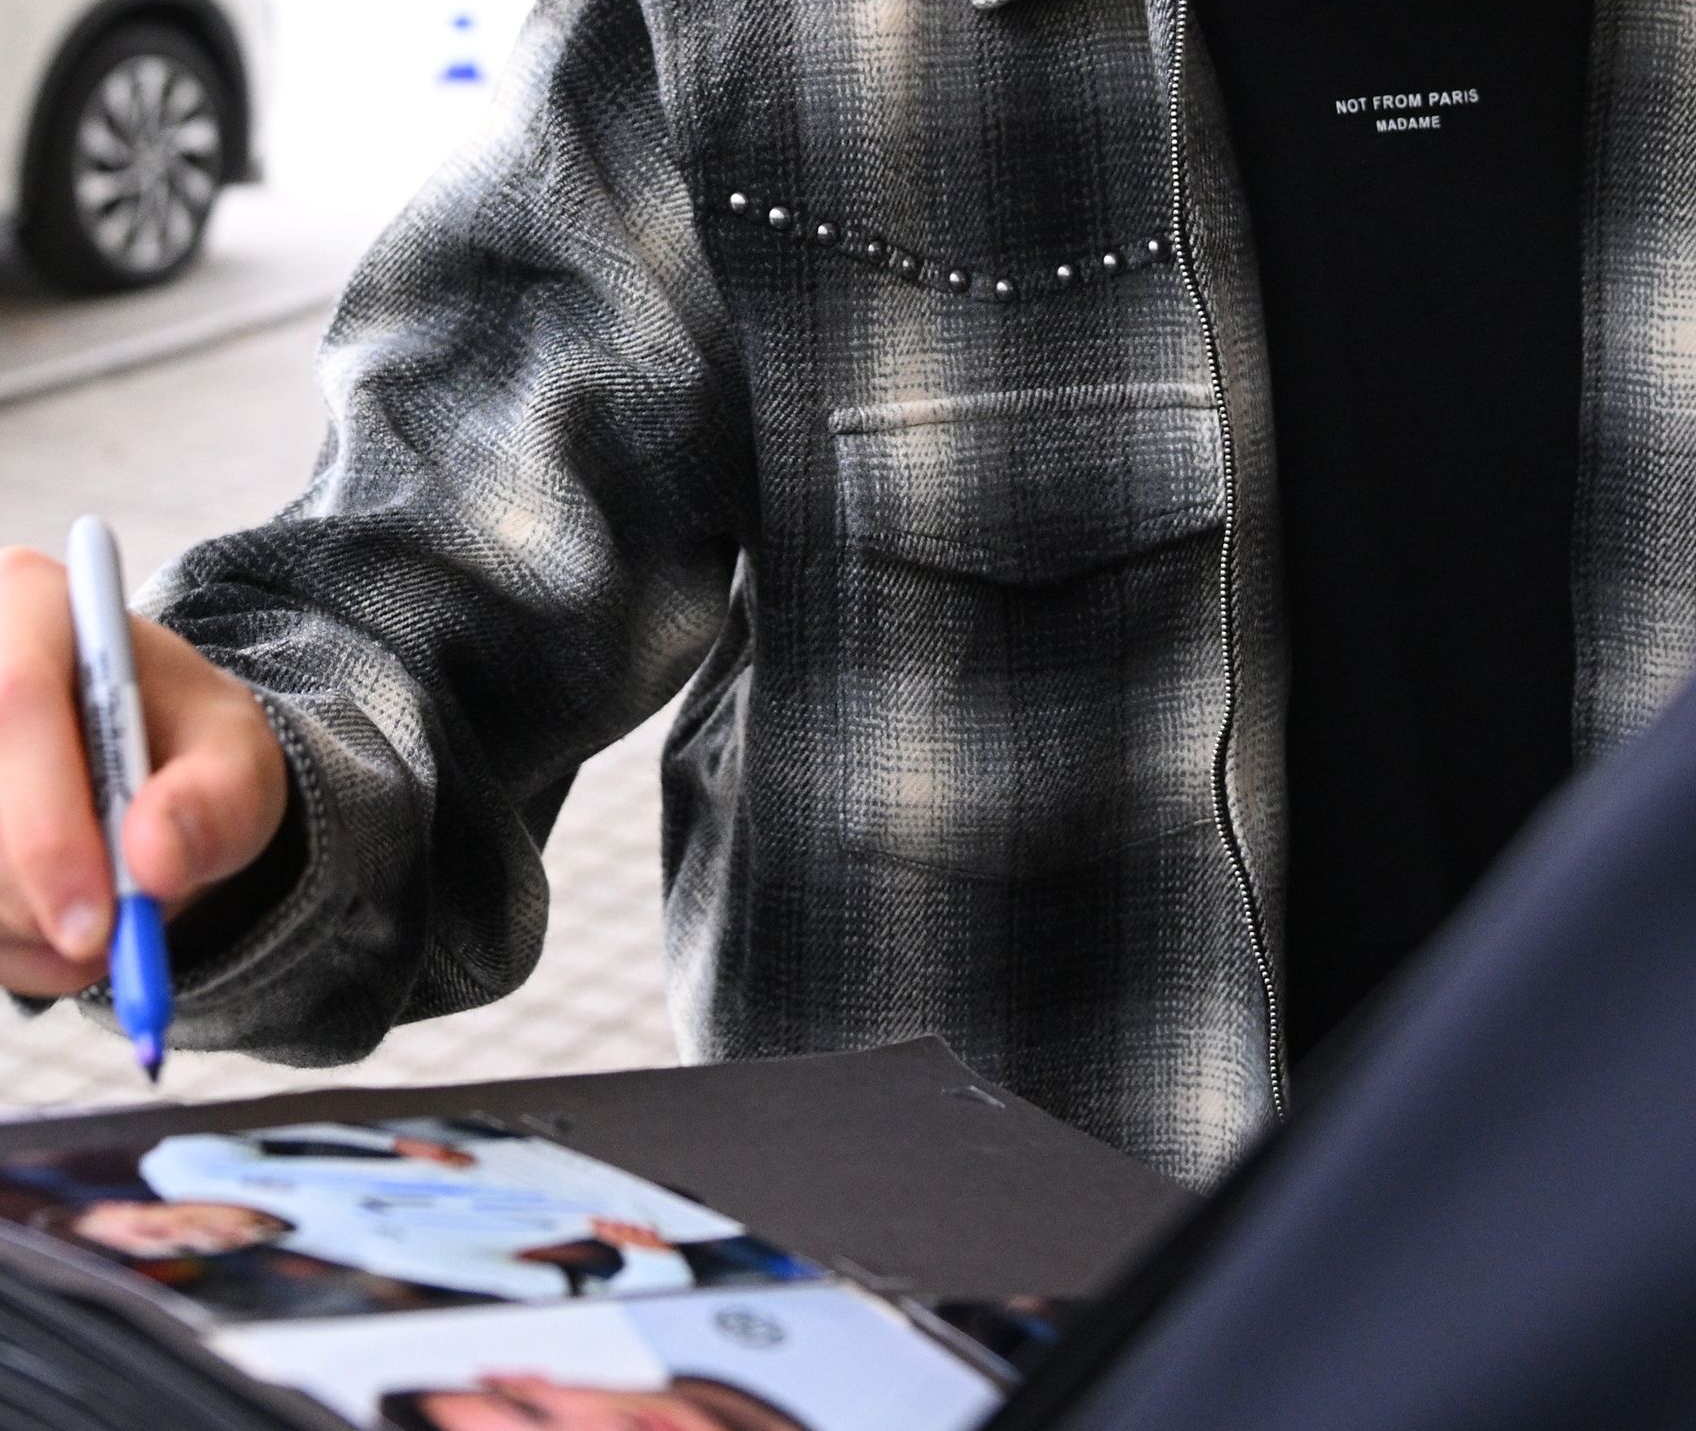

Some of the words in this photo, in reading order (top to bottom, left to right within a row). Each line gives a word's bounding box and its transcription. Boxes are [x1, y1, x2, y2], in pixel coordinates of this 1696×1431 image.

[1335, 97, 1367, 115] NOT
[1372, 93, 1423, 111] FROM
[1428, 88, 1480, 107] PARIS
[1375, 115, 1441, 133] MADAME
